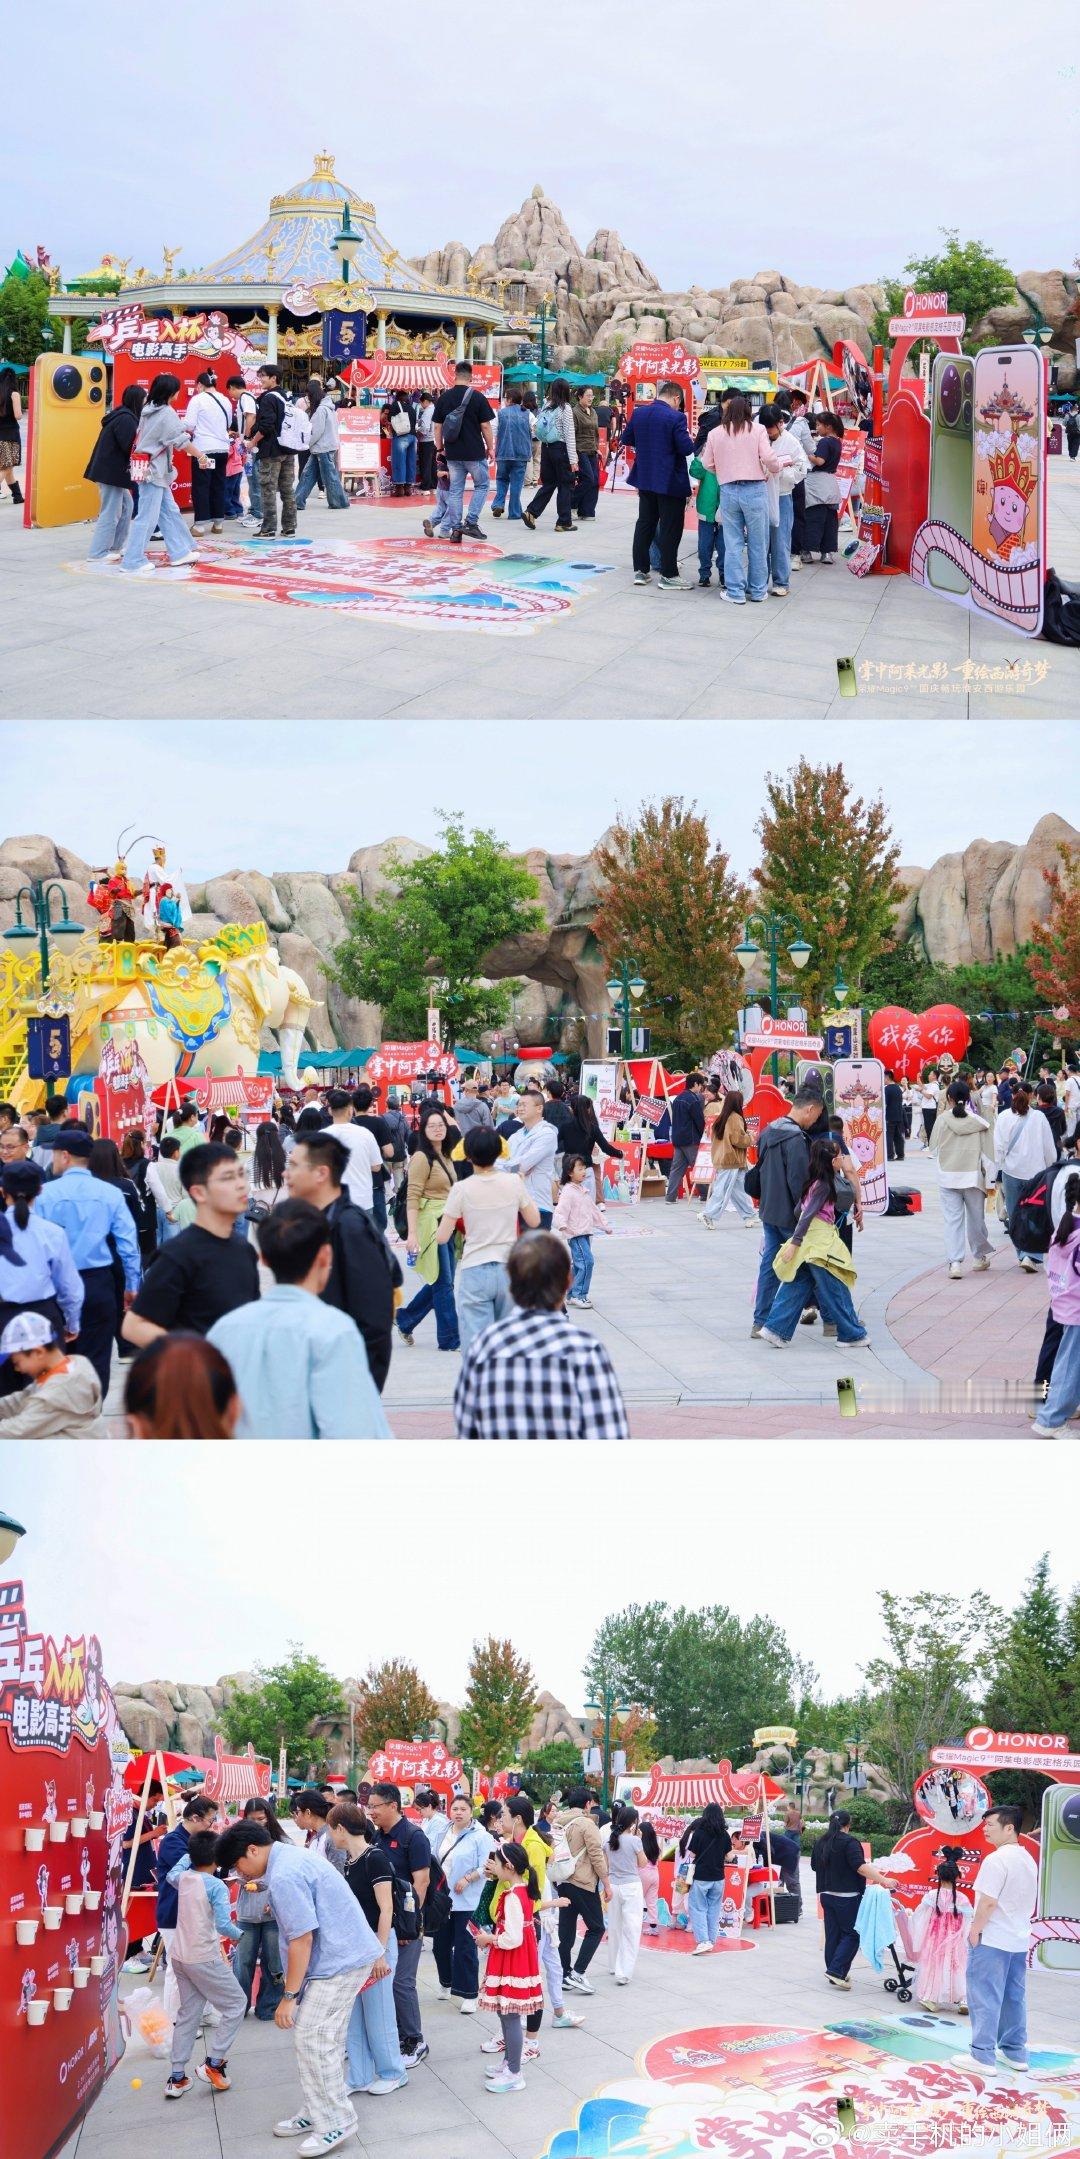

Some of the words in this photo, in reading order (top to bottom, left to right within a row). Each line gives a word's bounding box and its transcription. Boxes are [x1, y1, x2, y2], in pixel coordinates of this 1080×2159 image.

[915, 294, 946, 311] HONOR
[109, 316, 203, 349] 乒乓入杯
[339, 321, 355, 345] 5
[131, 342, 188, 358] 电影高手
[621, 356, 699, 376] 掌中阿莱光影
[774, 1020, 805, 1032] HONOR
[49, 1029, 62, 1059] 5
[835, 1033, 845, 1046] 5
[878, 1023, 955, 1052] 我爱你
[12, 1695, 71, 1744] 电影高手
[997, 1734, 1066, 1749] HONOR
[372, 1754, 460, 1780] 掌中阿莱光影
